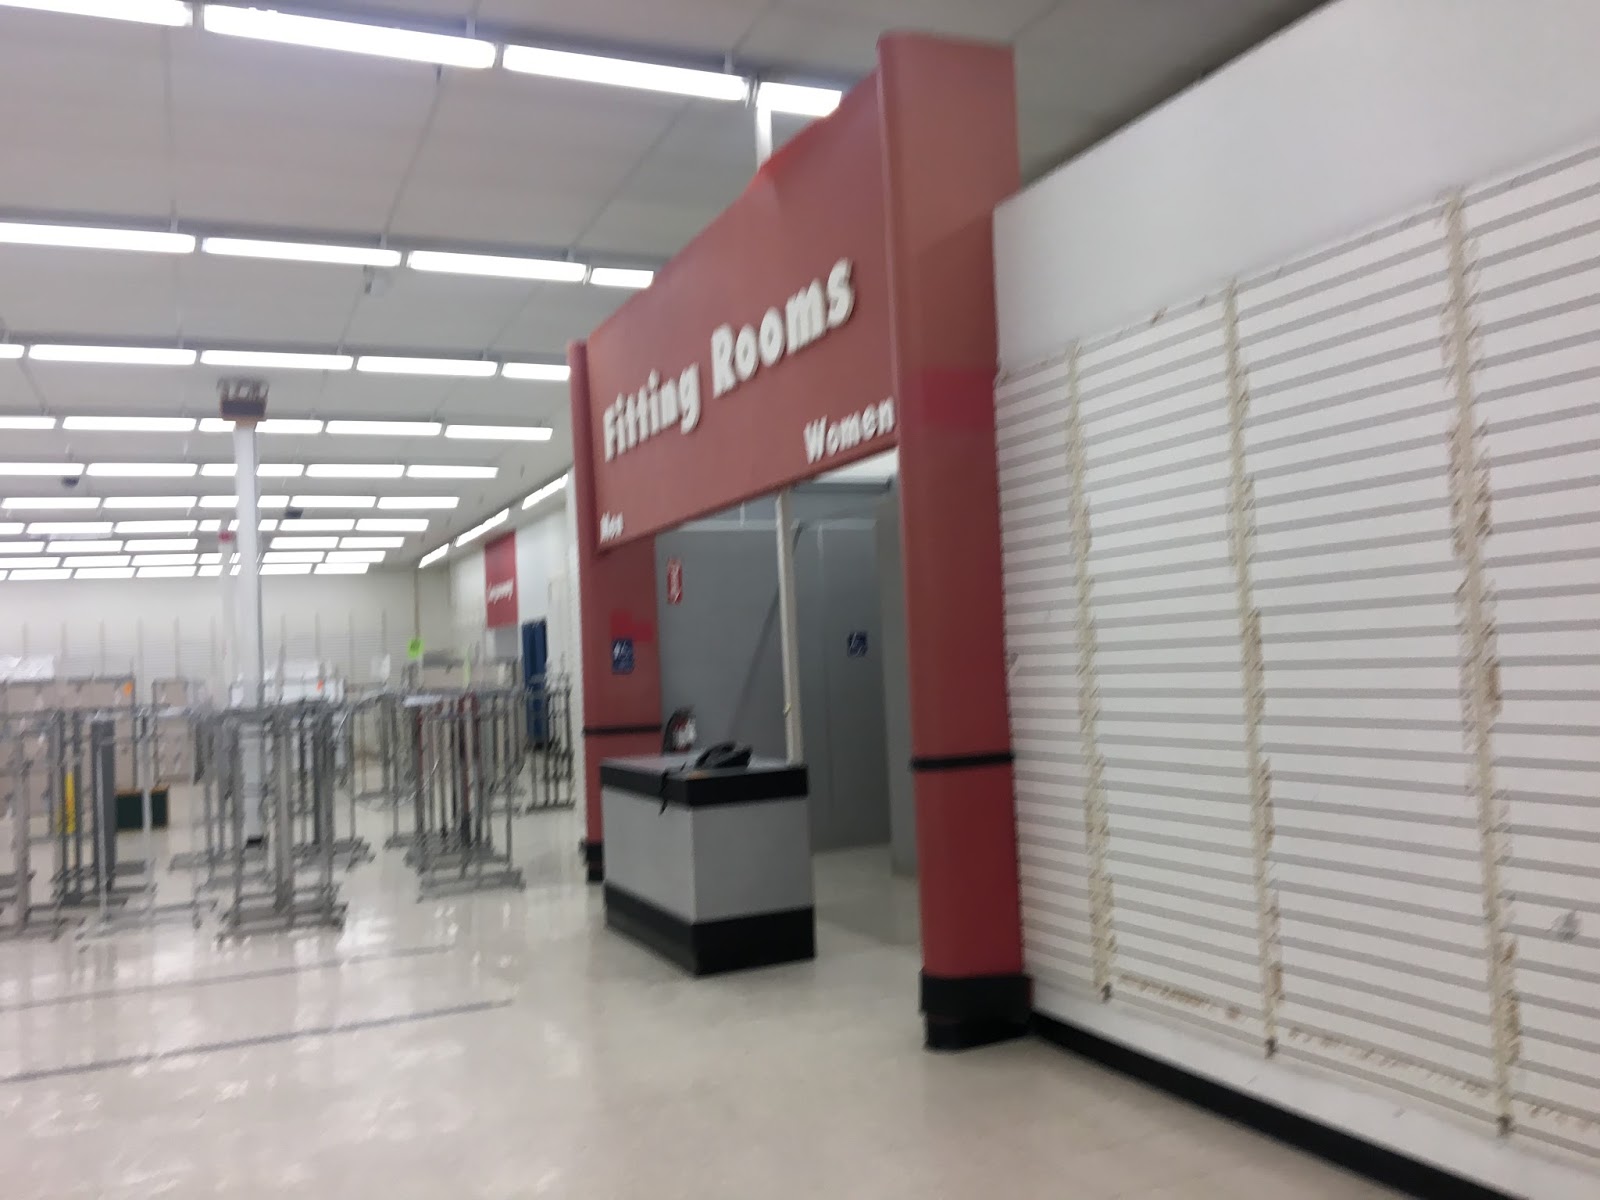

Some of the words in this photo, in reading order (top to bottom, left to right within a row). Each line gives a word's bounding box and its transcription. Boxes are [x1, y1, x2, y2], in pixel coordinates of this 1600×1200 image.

[603, 362, 701, 463] Fitting
[710, 256, 855, 399] Rooms
[803, 396, 895, 465] Women
